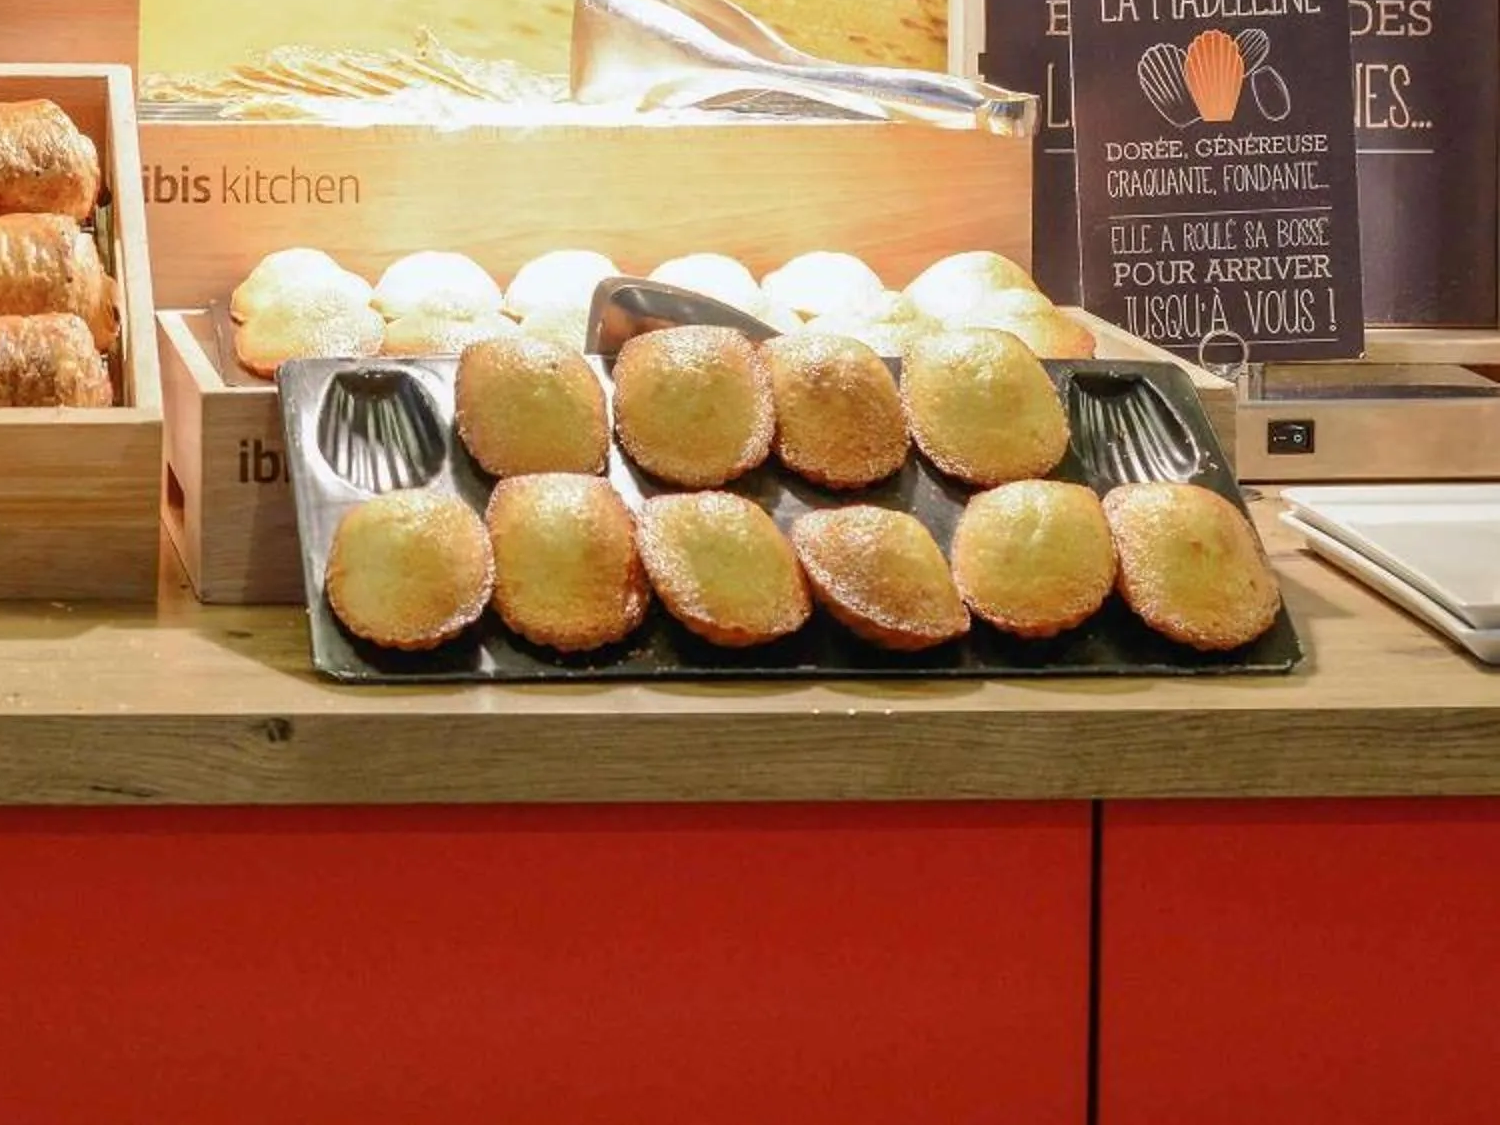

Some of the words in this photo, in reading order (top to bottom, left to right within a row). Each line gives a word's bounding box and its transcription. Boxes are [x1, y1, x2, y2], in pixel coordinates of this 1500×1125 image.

[1195, 132, 1329, 159] GÉNÉREUSE
[142, 165, 212, 204] ibis
[221, 165, 360, 204] kitchen
[1106, 165, 1218, 199] CRAQUANTE,
[1111, 225, 1153, 255] ELLE
[1161, 225, 1175, 253] A
[1183, 218, 1237, 252] ROULÉ
[1244, 220, 1269, 250] SA
[1277, 216, 1330, 248] BOSSE
[1113, 259, 1198, 287] POUR
[1203, 254, 1334, 283] ARRIVER
[1243, 287, 1316, 335] VOUS
